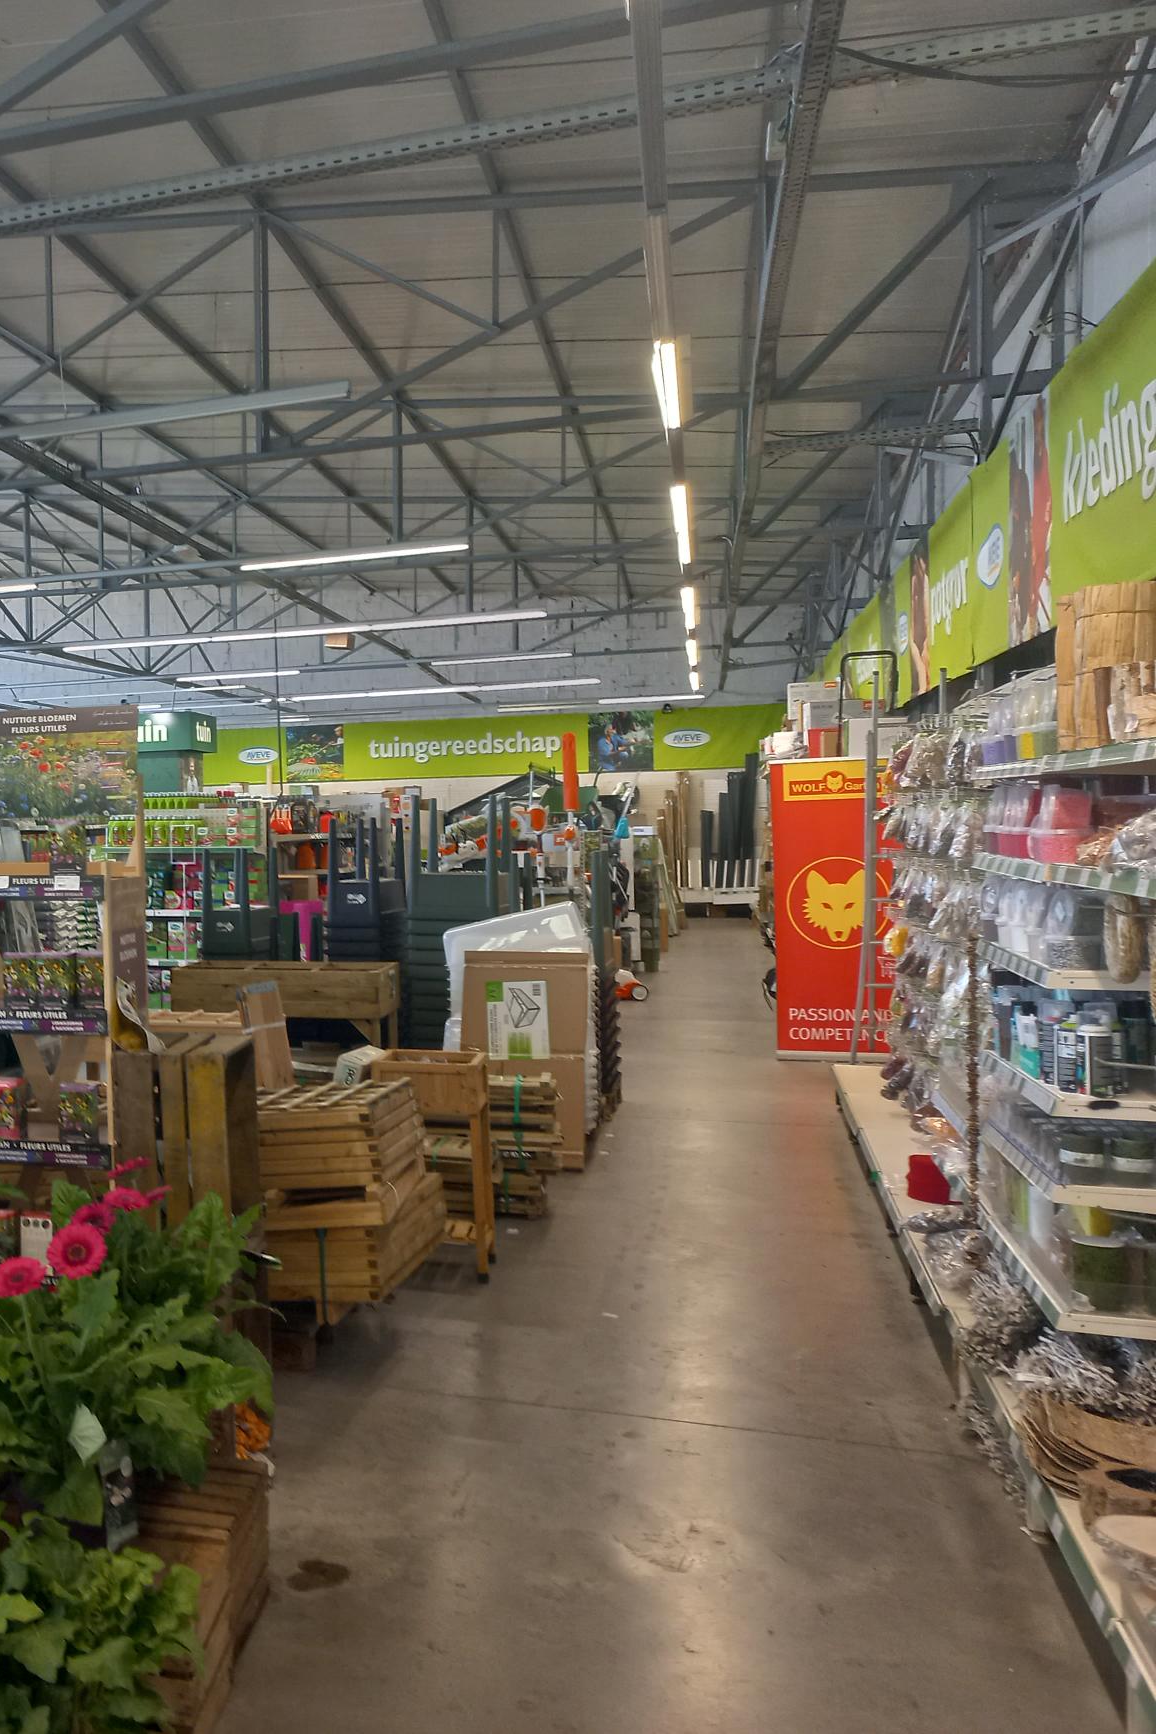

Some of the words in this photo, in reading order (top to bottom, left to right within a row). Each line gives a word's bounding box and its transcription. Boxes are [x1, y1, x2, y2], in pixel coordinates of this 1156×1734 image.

[1063, 378, 1156, 524] kleding
[2, 715, 37, 725] NUTTIGE
[38, 714, 76, 723] BLOEMEN
[11, 726, 40, 734] FLEURS
[41, 724, 67, 733] UTILES
[196, 720, 212, 743] tuin
[368, 731, 561, 763] tuingereedschap
[246, 750, 271, 760] AVEVE
[791, 782, 826, 793] WOLF
[789, 1007, 856, 1021] PASSION
